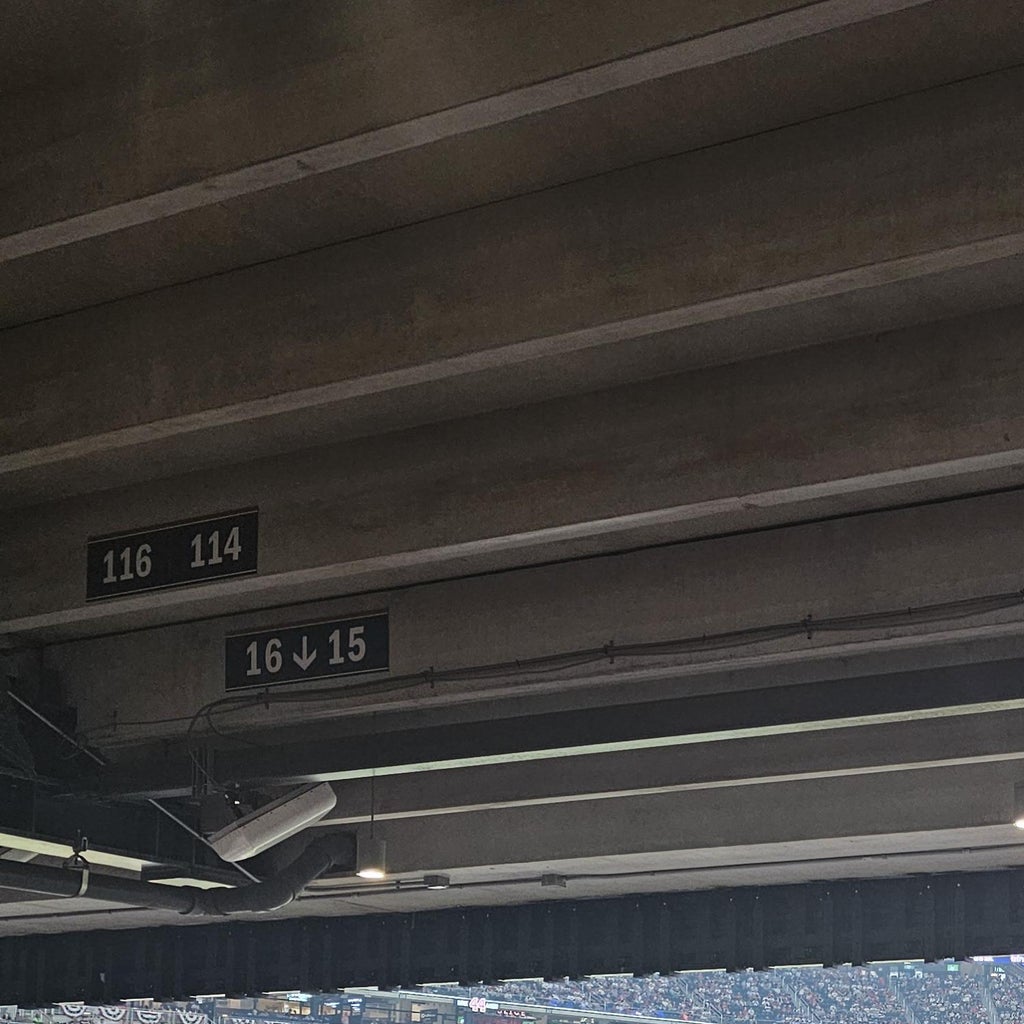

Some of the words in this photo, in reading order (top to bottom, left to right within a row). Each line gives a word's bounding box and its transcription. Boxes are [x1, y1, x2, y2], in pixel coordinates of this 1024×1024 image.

[103, 544, 152, 583] 116
[191, 527, 242, 568] 114
[246, 638, 283, 676] 16
[328, 626, 366, 666] 15
[468, 997, 487, 1013] 44
